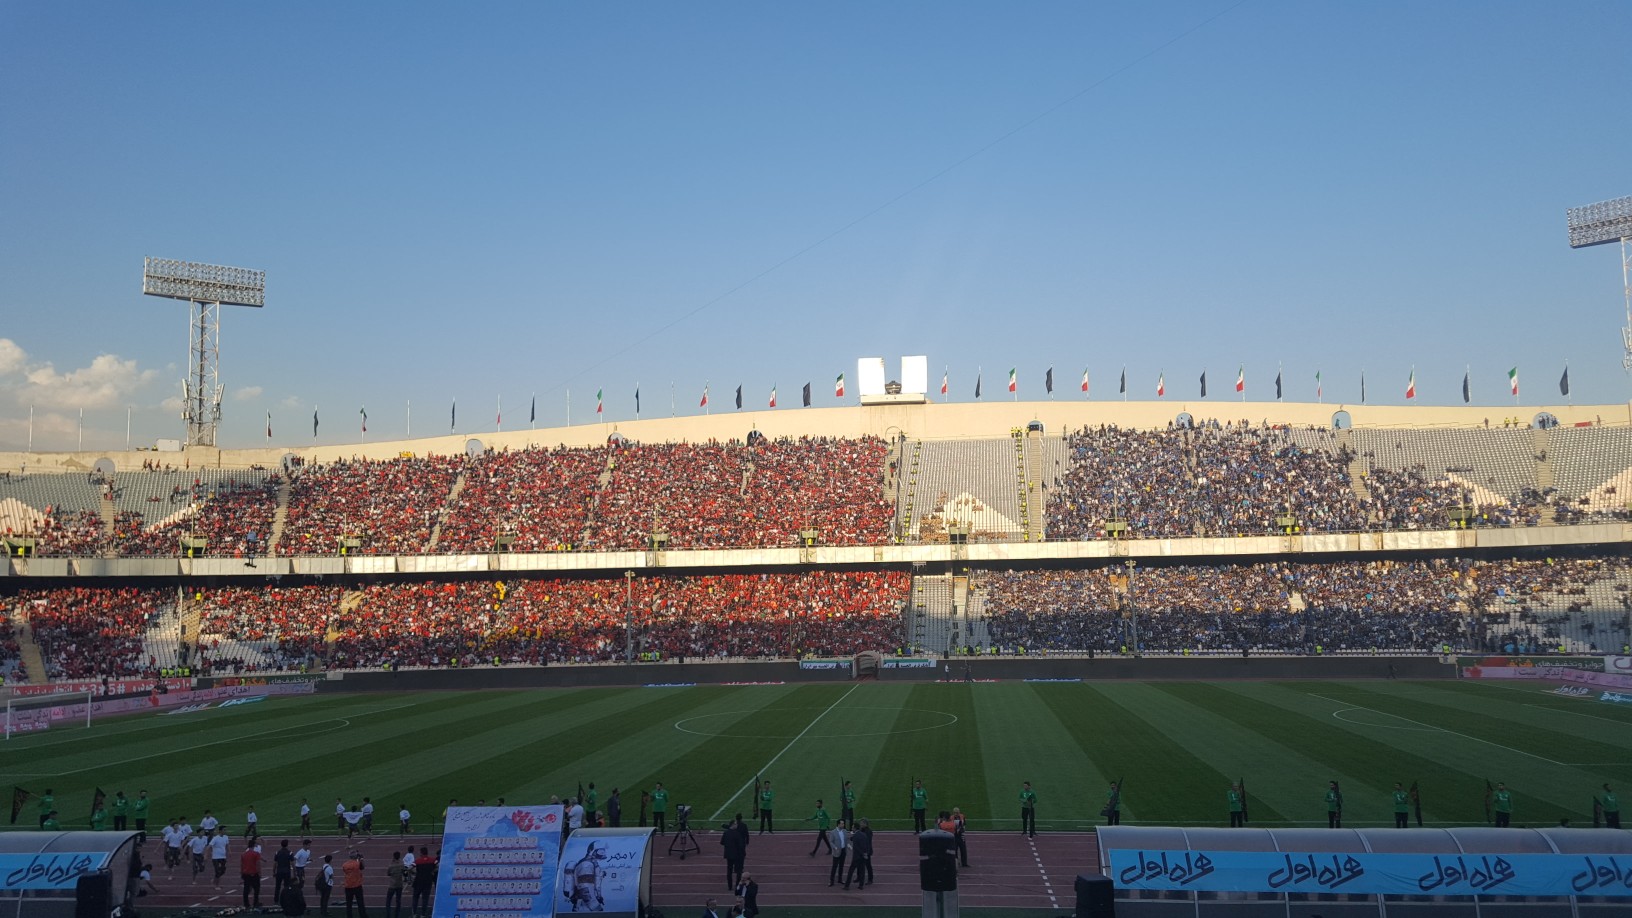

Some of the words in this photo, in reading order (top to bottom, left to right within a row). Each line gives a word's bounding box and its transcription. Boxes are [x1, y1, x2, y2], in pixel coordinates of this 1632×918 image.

[6, 855, 60, 887] اول
[606, 852, 628, 863] مهر
[629, 851, 637, 860] ۷
[1120, 851, 1169, 885] اول
[1168, 852, 1215, 886] همراه
[1267, 853, 1317, 889] اول
[1317, 853, 1364, 889] همراه
[1418, 855, 1468, 892] اول
[1469, 855, 1516, 892] همراه
[1571, 856, 1622, 892] اول
